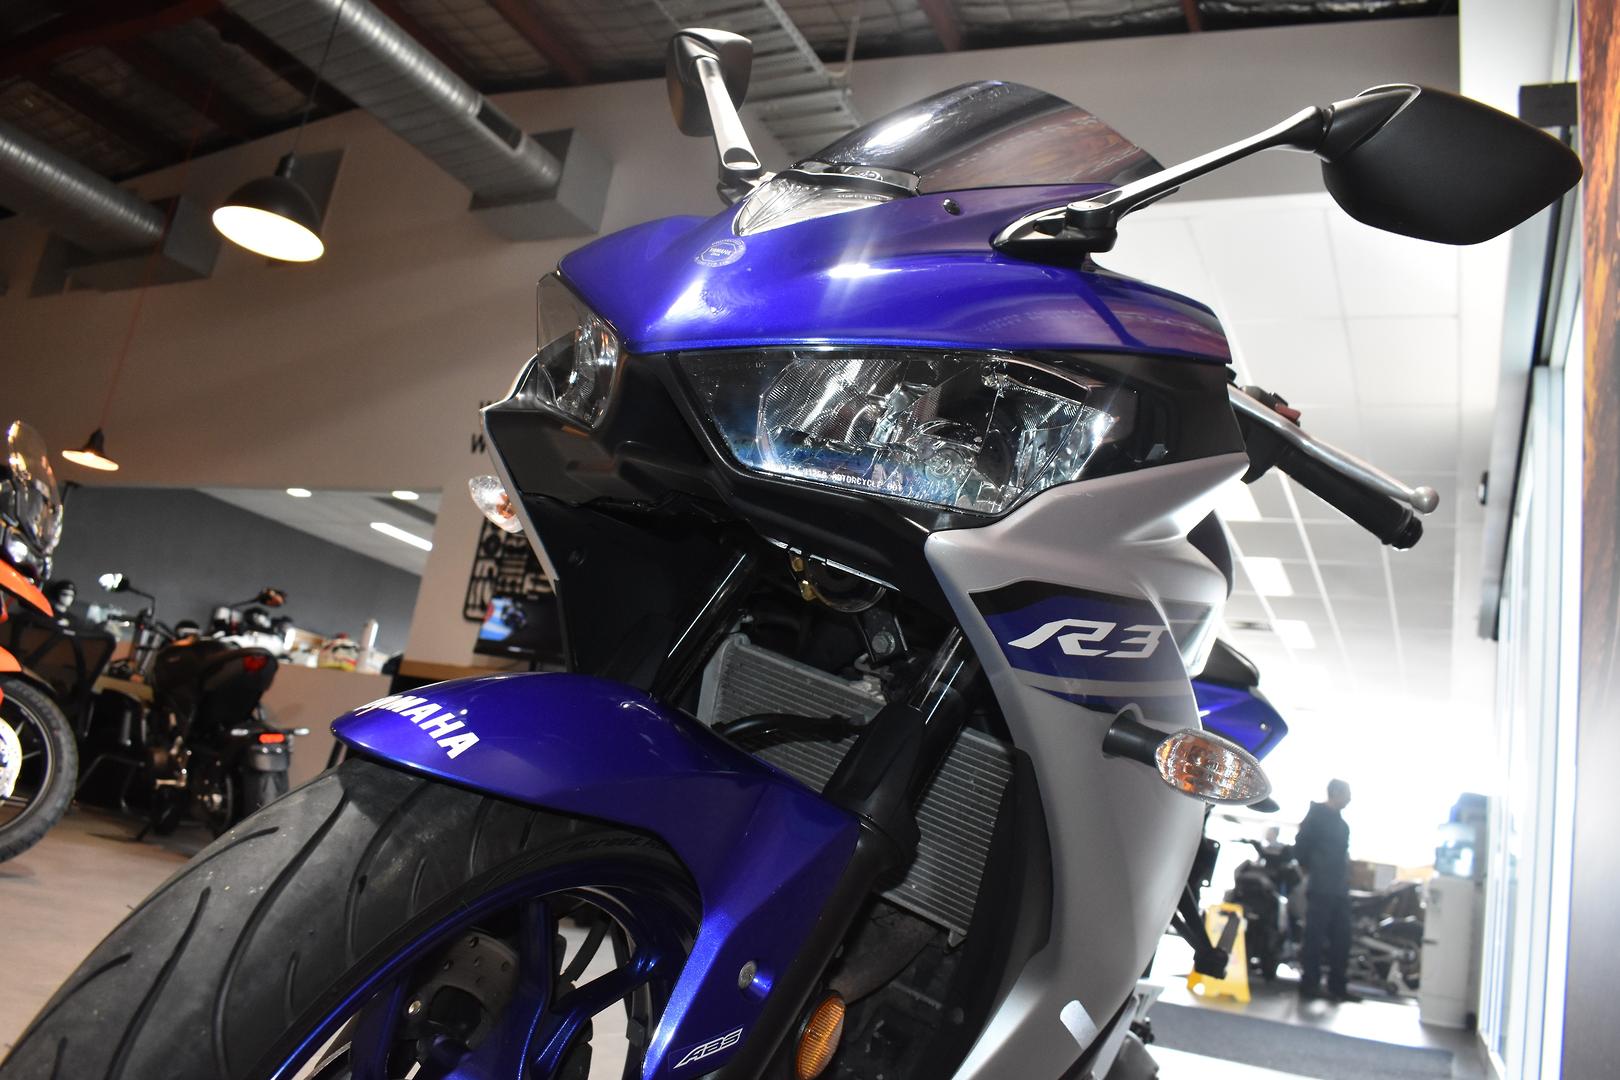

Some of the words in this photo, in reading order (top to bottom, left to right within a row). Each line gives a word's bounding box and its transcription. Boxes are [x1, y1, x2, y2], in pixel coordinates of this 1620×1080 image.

[1008, 618, 1170, 658] R3
[353, 694, 480, 759] AMAHA
[673, 1028, 743, 1069] ABS
